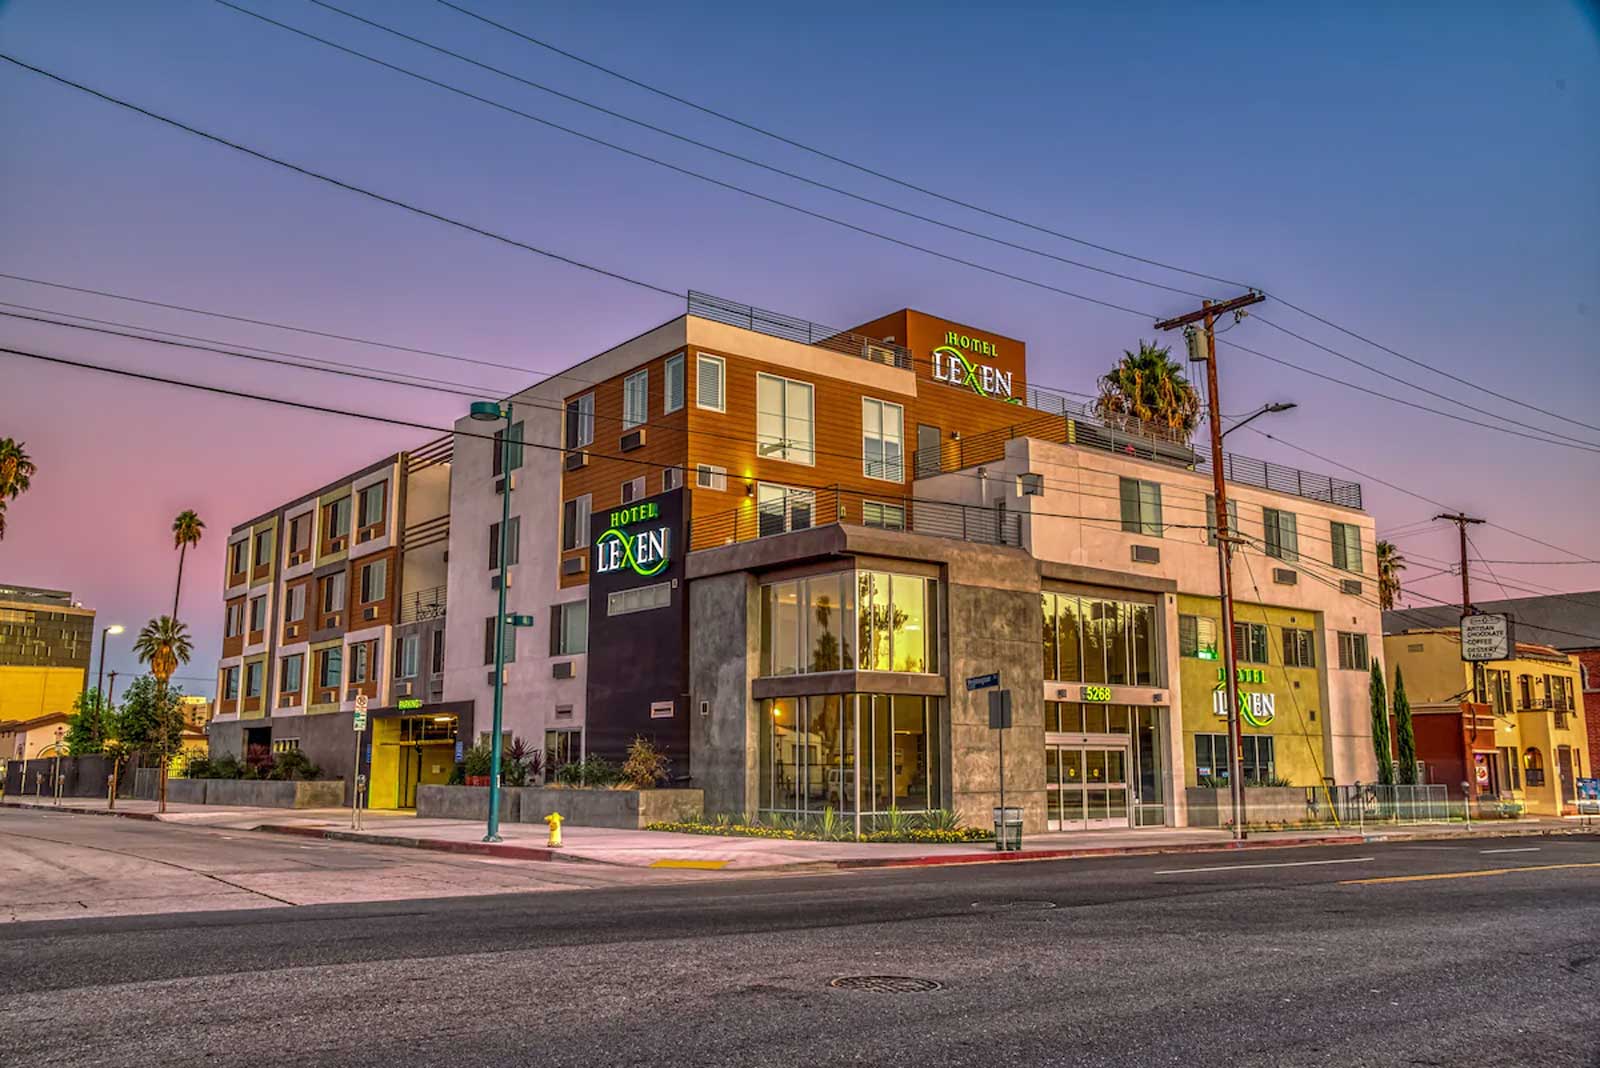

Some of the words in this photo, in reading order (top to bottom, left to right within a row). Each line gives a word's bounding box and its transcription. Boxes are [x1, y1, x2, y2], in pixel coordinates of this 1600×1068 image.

[946, 331, 998, 357] HOTEL
[932, 345, 1017, 402] LEXEN
[610, 502, 659, 527] HOTEL
[595, 528, 671, 576] LEXEN
[1467, 630, 1504, 638] CHOCOLATE
[1217, 667, 1267, 683] OTEL
[1087, 686, 1111, 701] 5268
[1213, 682, 1275, 727] LXEN
